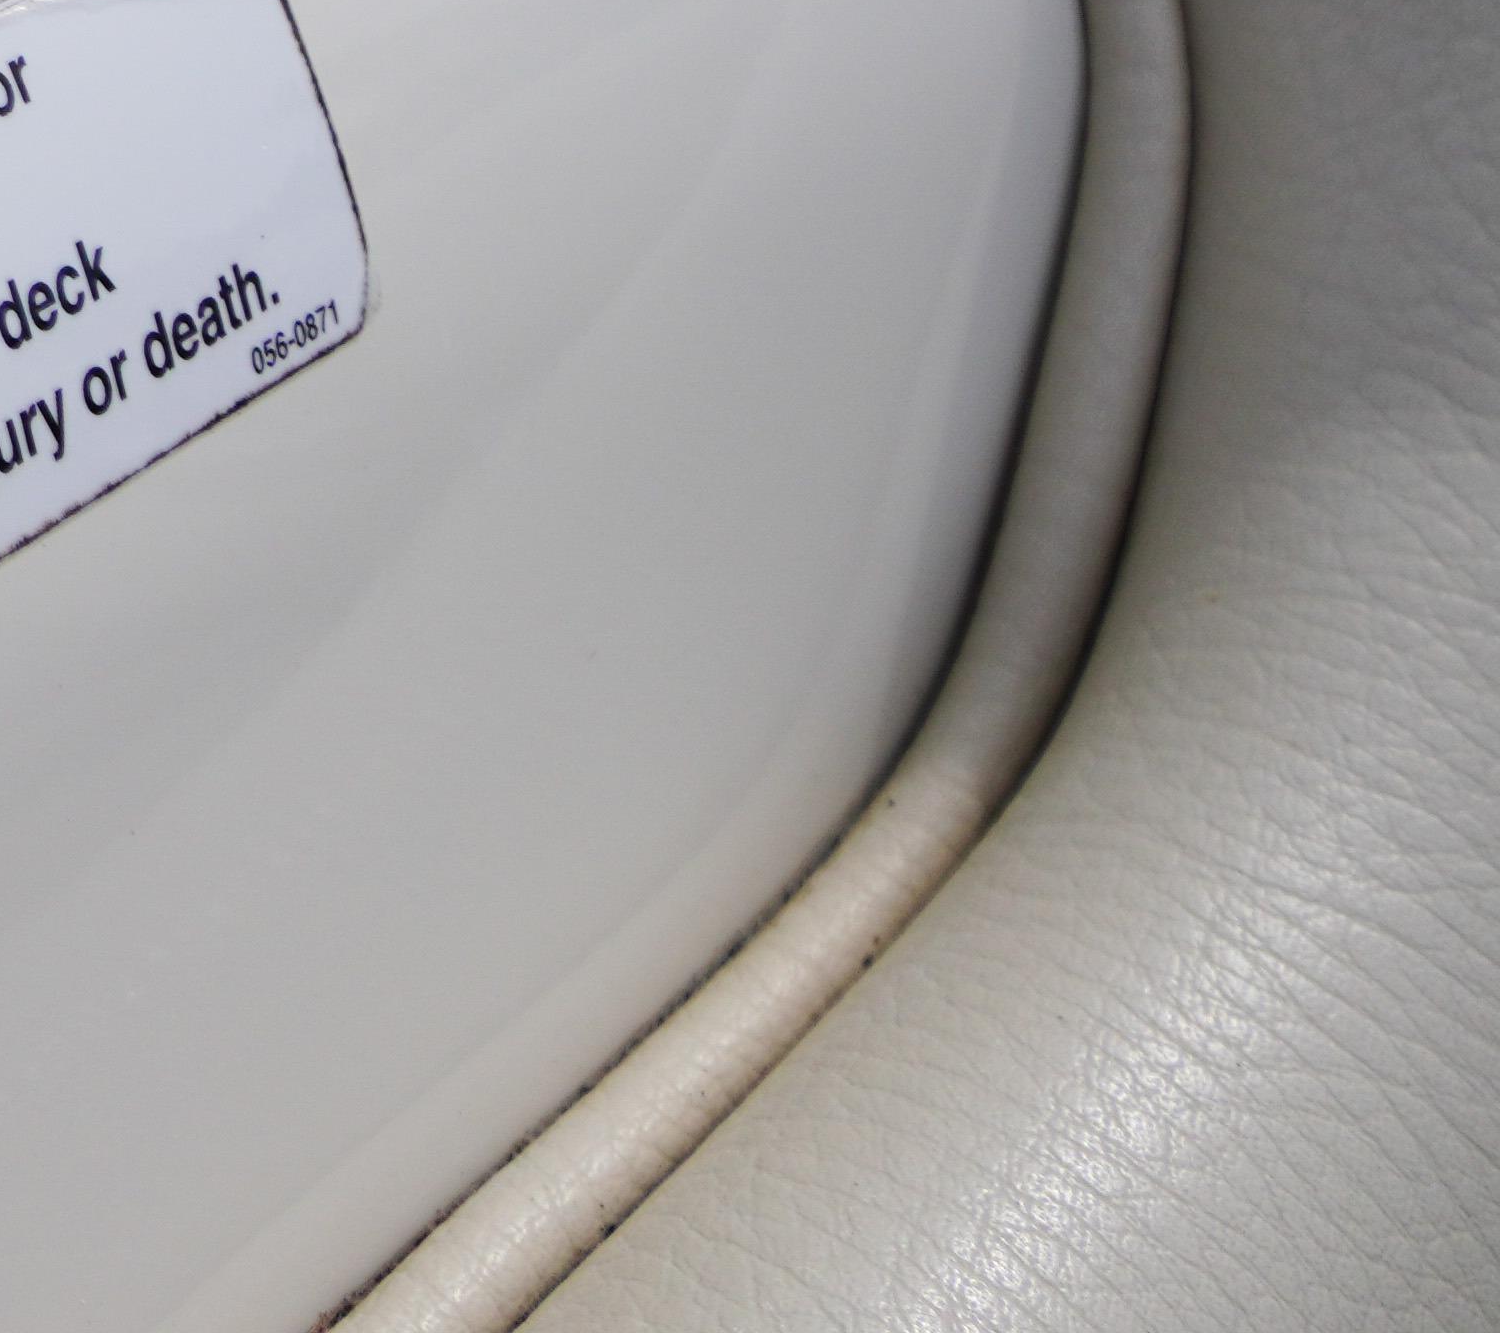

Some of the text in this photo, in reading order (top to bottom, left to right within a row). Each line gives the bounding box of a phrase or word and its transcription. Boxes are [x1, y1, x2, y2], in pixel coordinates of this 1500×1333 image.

[81, 348, 128, 416] or
[143, 262, 281, 379] death.
[251, 298, 340, 376] 056-0871
